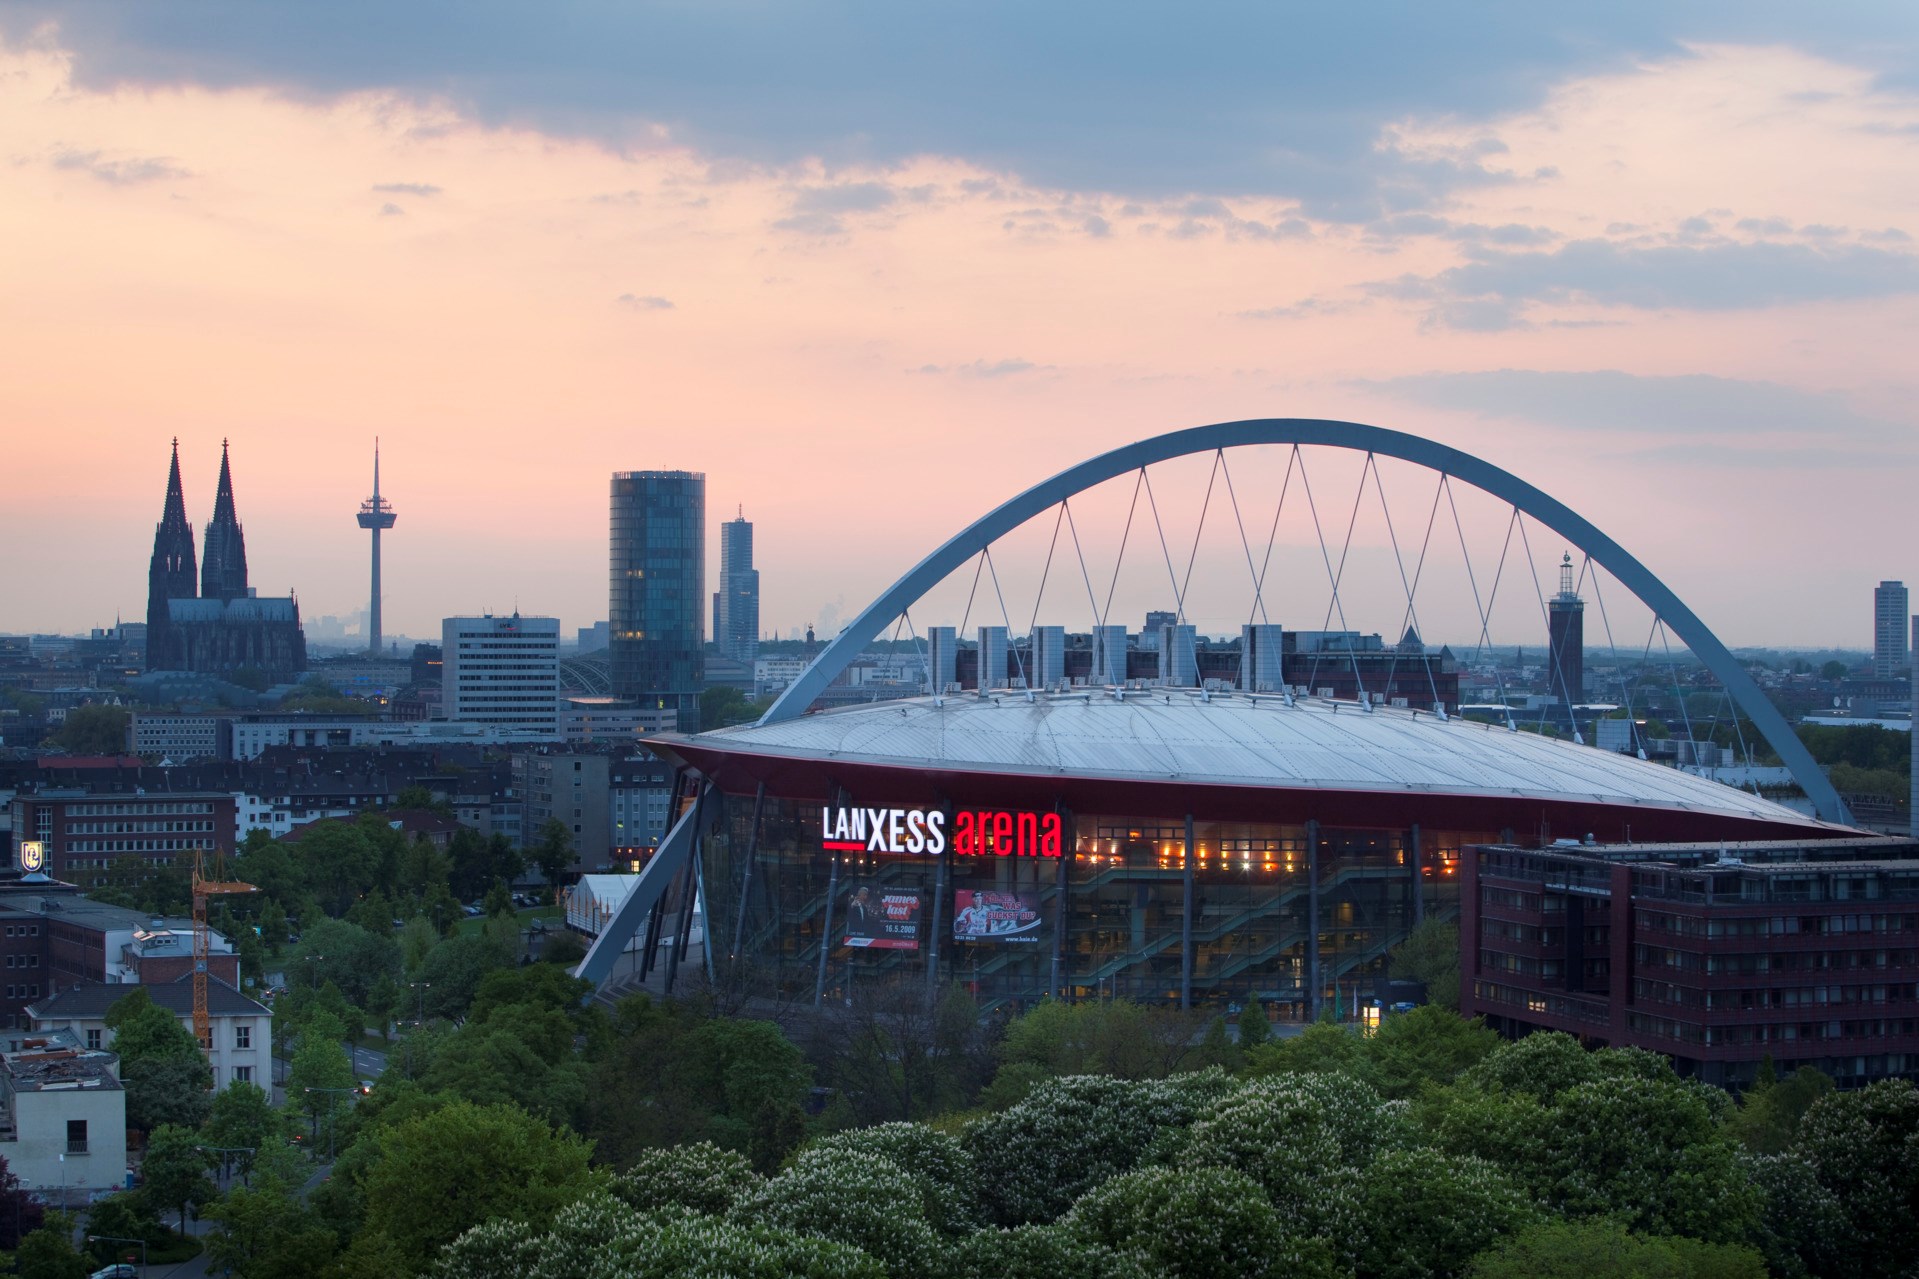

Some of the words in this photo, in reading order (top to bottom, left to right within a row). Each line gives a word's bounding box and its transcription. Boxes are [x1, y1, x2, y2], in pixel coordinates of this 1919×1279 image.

[823, 807, 945, 855] LANXESS
[956, 811, 1062, 857] arena
[1003, 902, 1021, 910] WAS
[885, 925, 916, 933] 16.5.2009
